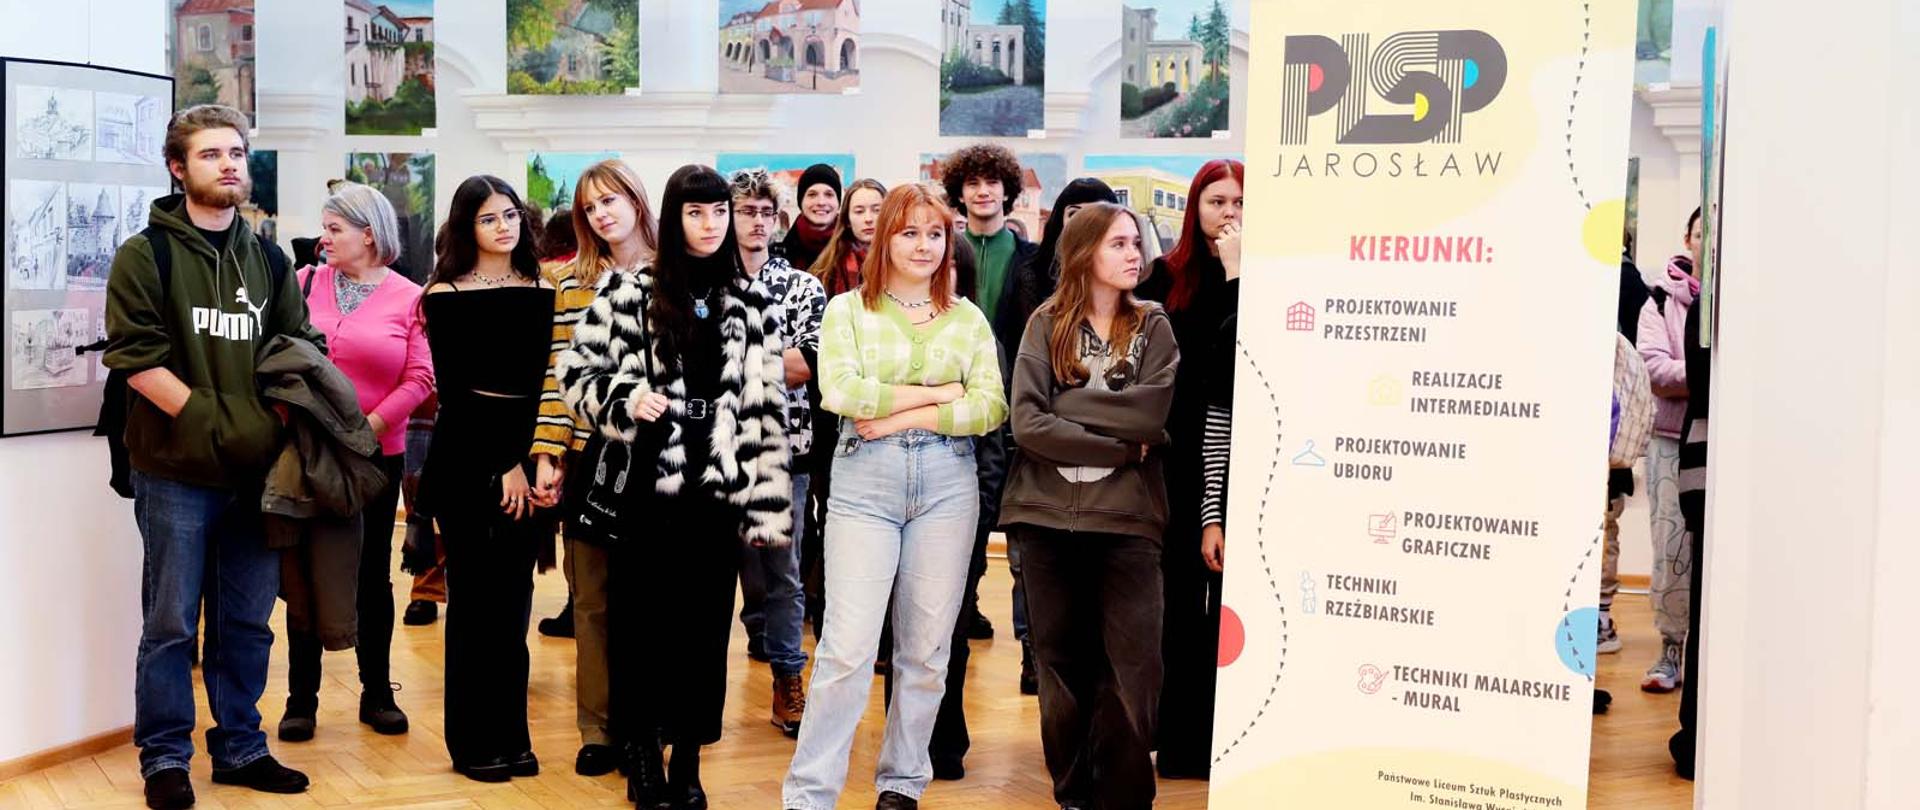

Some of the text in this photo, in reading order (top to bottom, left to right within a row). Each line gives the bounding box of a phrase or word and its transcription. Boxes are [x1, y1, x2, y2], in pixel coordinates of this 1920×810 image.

[1273, 152, 1503, 178] JAROSŁAW
[1349, 235, 1494, 264] KIERUNKI:
[1325, 299, 1457, 318] PROJEKTOWANIE
[1324, 324, 1427, 343] PRZESTRZENI
[1412, 371, 1503, 390] REALIZACJE
[1411, 398, 1541, 419] INTERMEDIALNE
[1335, 437, 1467, 459] PROJEKTOWANIE
[1334, 463, 1393, 481] UBIORU
[1404, 512, 1539, 537] PROJEKTOWANIE
[1402, 538, 1491, 560] GRAFICZNE
[1327, 574, 1397, 596] TECHNIKI
[1325, 599, 1435, 626] RZEŹBIARSKIE
[1393, 665, 1571, 702] TECHNIKI MALARSKIE
[1404, 691, 1460, 713] MURAL
[1378, 770, 1431, 788] Państwowe
[1434, 778, 1466, 793] Liceum
[1469, 784, 1496, 797] Sztuk
[1499, 788, 1562, 807] Plastycznych
[1410, 791, 1426, 803] Im.
